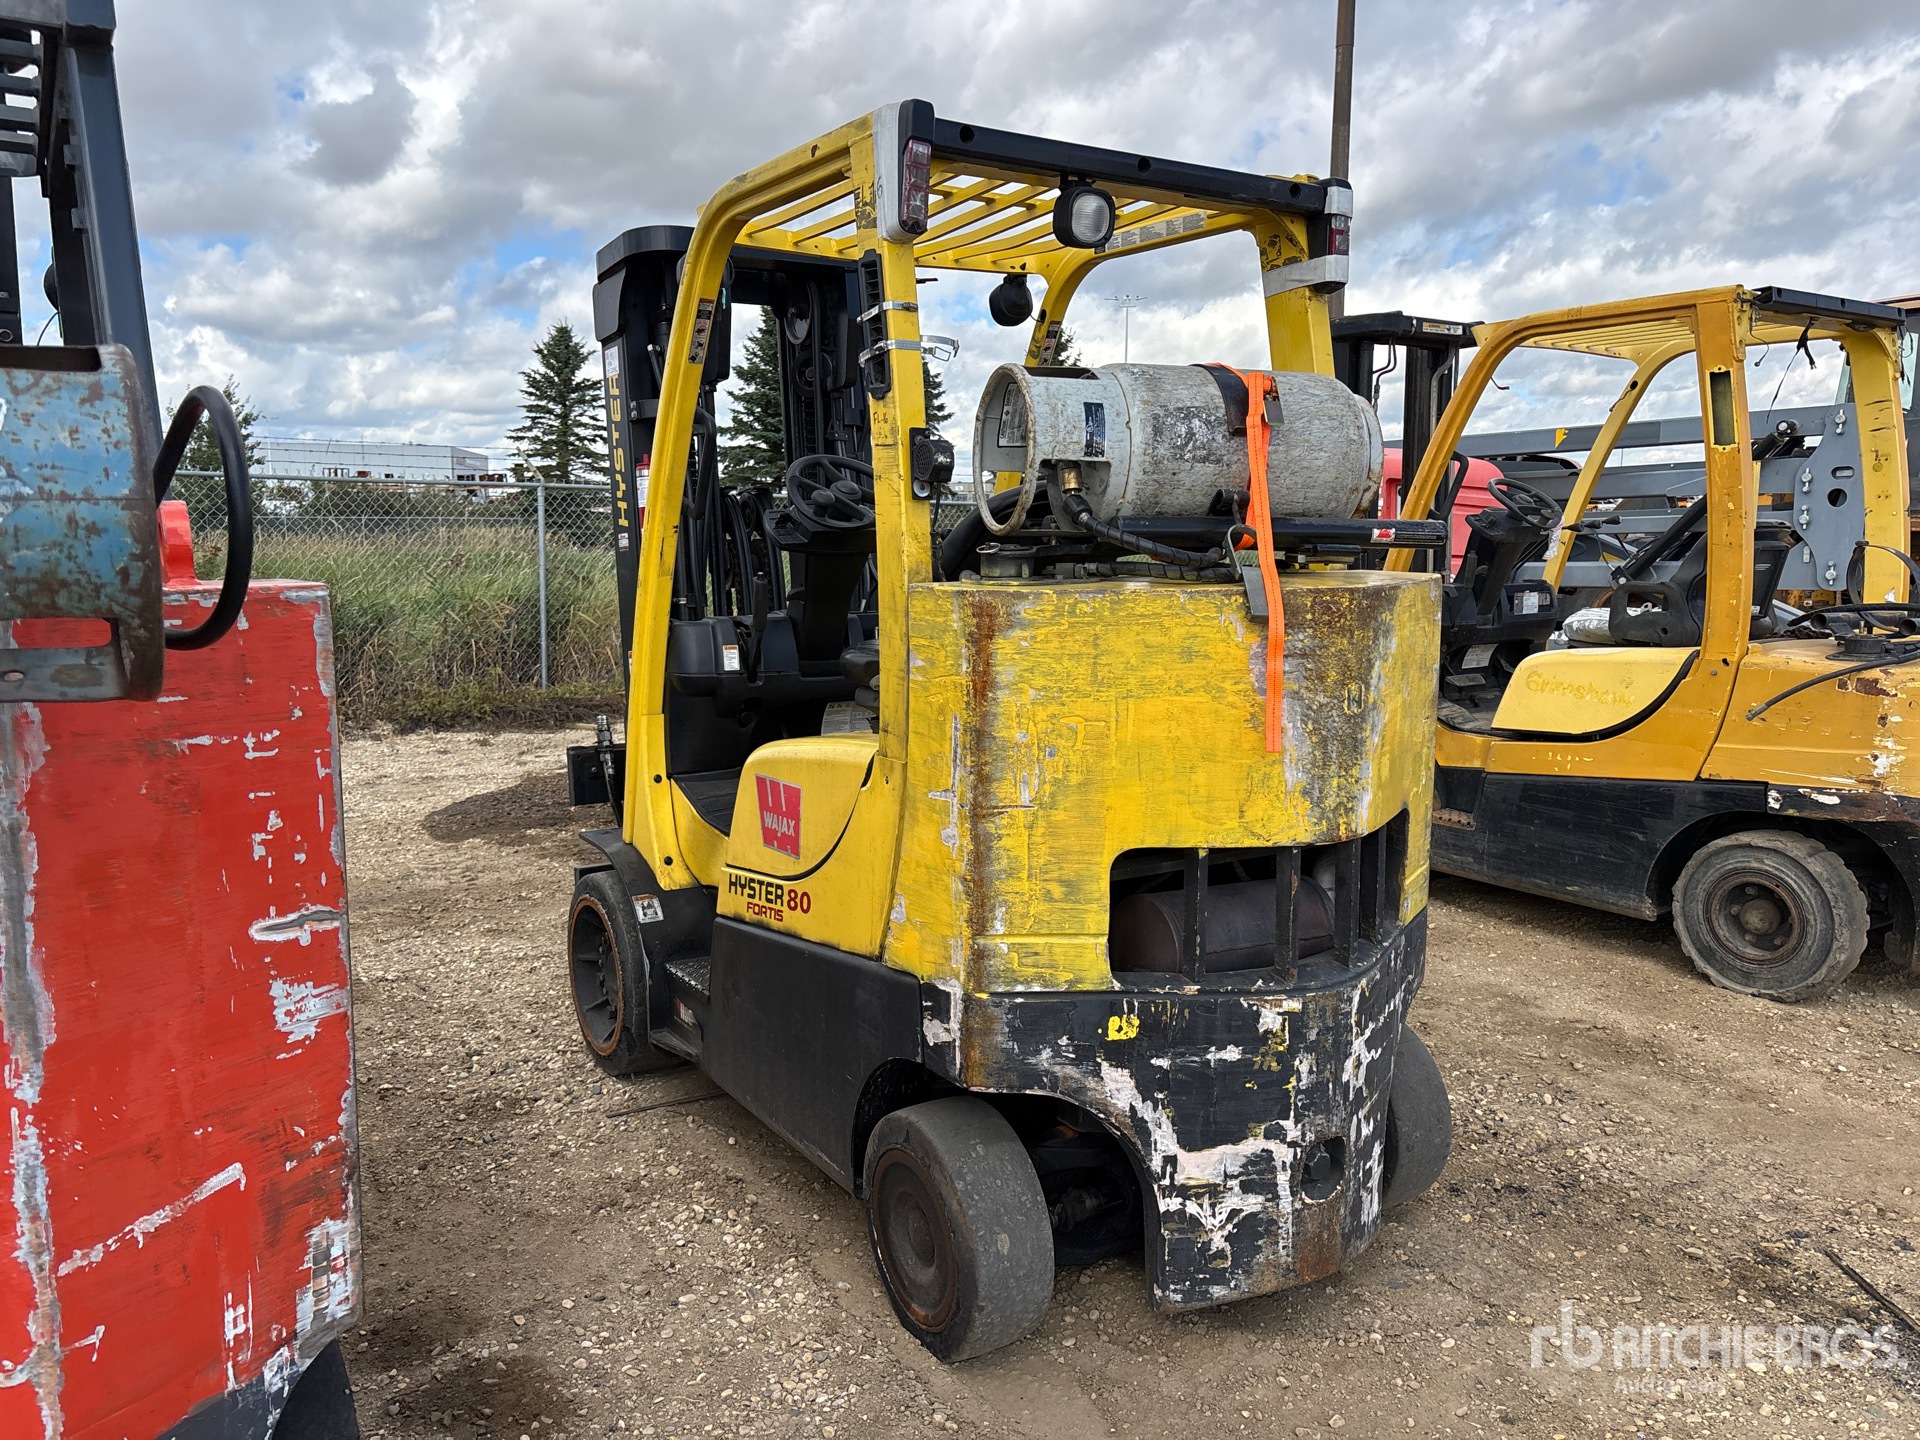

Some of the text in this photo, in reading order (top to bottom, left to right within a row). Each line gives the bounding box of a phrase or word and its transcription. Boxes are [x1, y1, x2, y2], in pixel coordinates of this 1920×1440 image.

[609, 374, 629, 527] HYSTER
[763, 810, 796, 837] WAJAX
[728, 873, 811, 914] HYSTER 80
[746, 901, 784, 922] FORTIS
